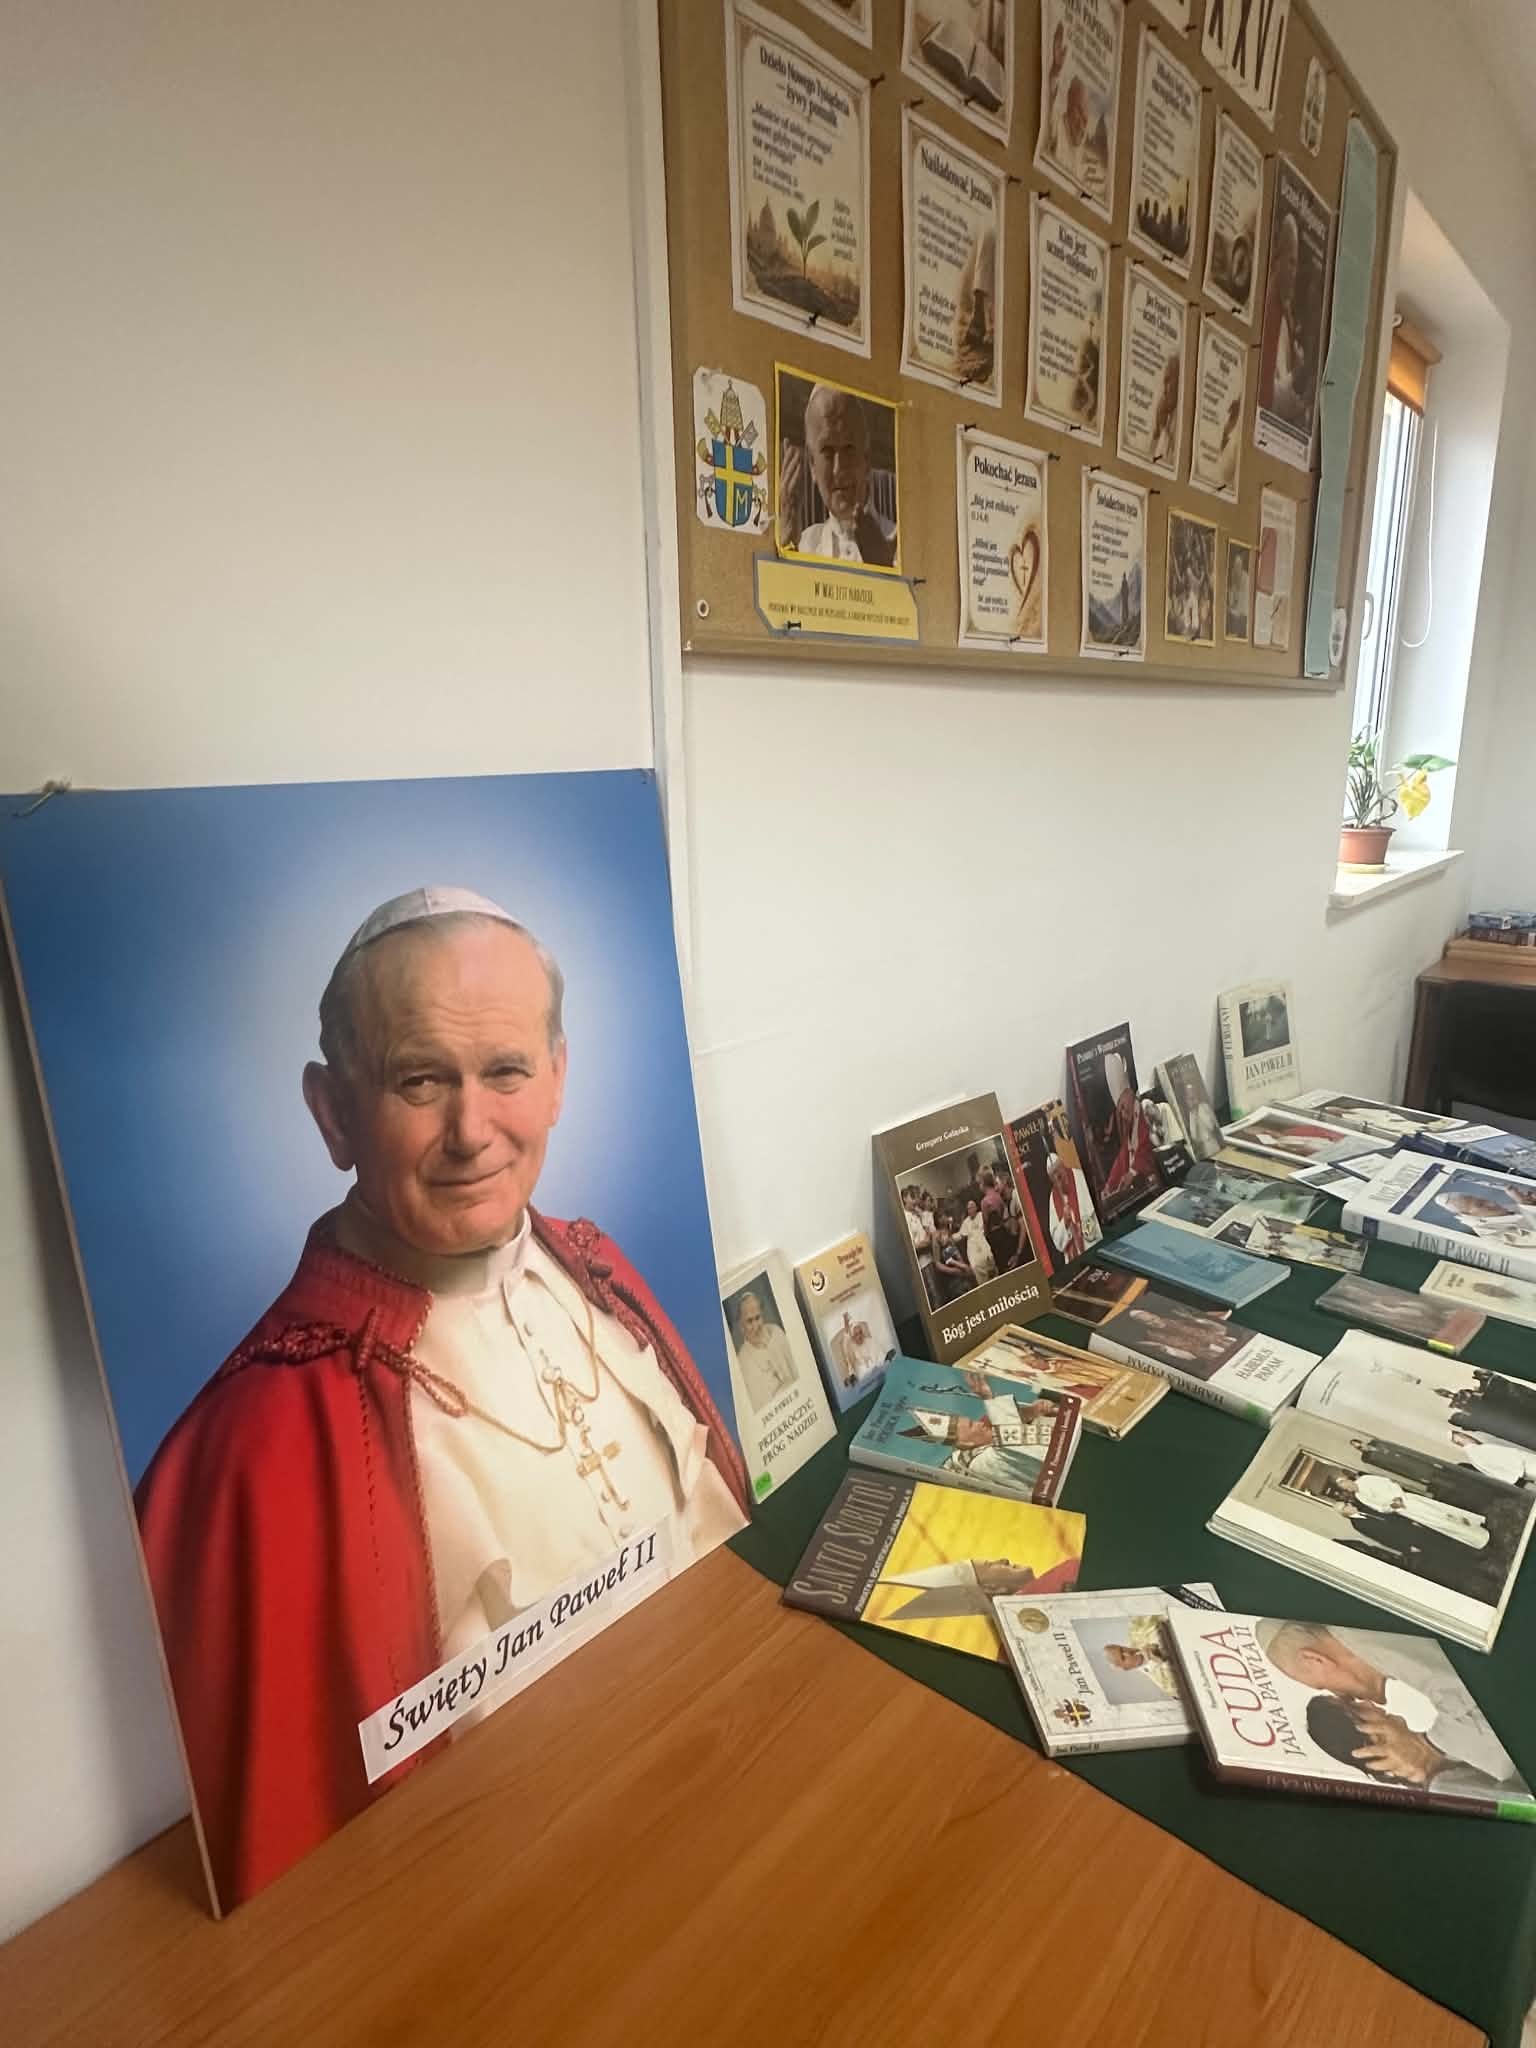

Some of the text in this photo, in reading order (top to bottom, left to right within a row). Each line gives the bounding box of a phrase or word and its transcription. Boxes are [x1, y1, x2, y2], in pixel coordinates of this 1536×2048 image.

[974, 455, 1013, 482] Pokochać
[1411, 1231, 1440, 1255] JAN
[1499, 1255, 1511, 1274] II
[941, 1284, 1041, 1345] Bóg jest miłością
[758, 1396, 815, 1453] PRZEKROCZYĆ
[762, 1411, 818, 1467] PRÓG NADZIEI
[793, 1477, 897, 1605] SANTO SUBITO!
[383, 1531, 657, 1751] Święty Jan Paweł II
[1052, 1630, 1067, 1643] II
[1077, 1676, 1096, 1697] Jan
[1200, 1625, 1277, 1748] CUDA
[1233, 1624, 1309, 1757] JANA PAWŁA II
